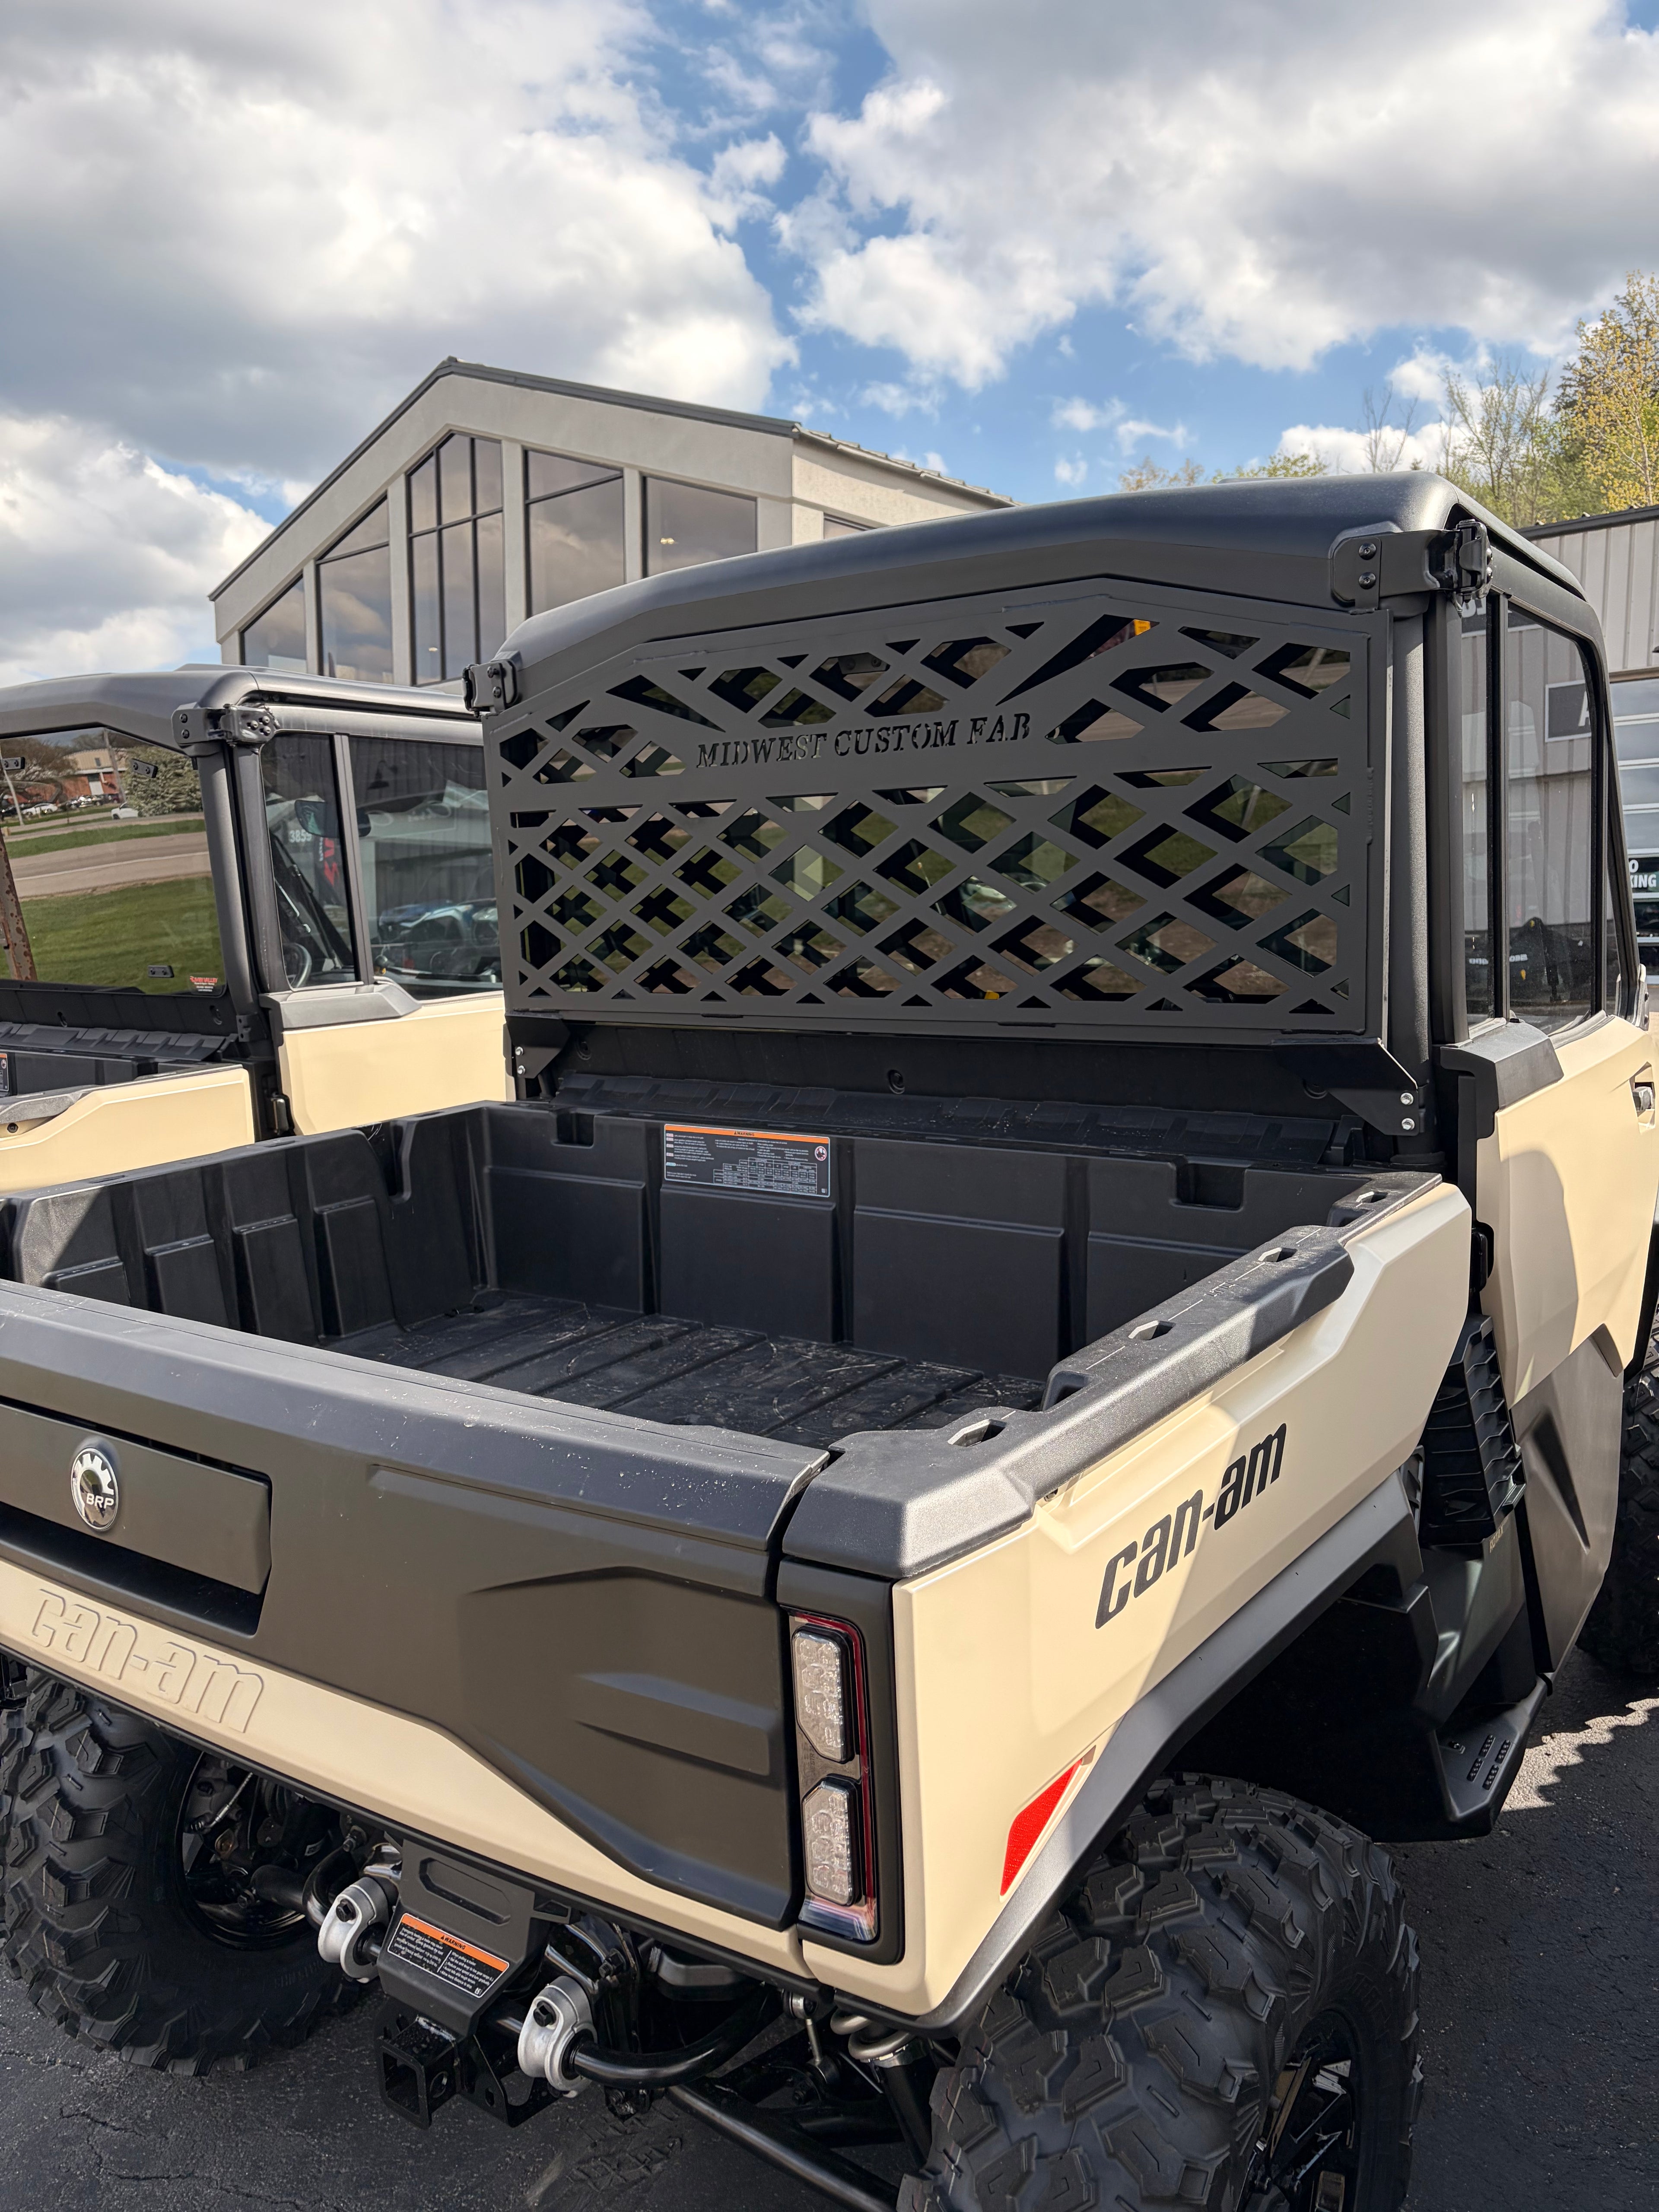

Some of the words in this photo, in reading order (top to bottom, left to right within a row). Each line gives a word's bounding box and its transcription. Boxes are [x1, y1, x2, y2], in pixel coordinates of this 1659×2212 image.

[696, 733, 827, 769] MIDWEST
[835, 720, 958, 757] CUSTOM
[966, 712, 1031, 745] FAB
[86, 1493, 114, 1508] BRP
[1095, 1423, 1287, 1629] can-am
[30, 1588, 264, 1733] can-am
[445, 1937, 466, 1950] WARNING
